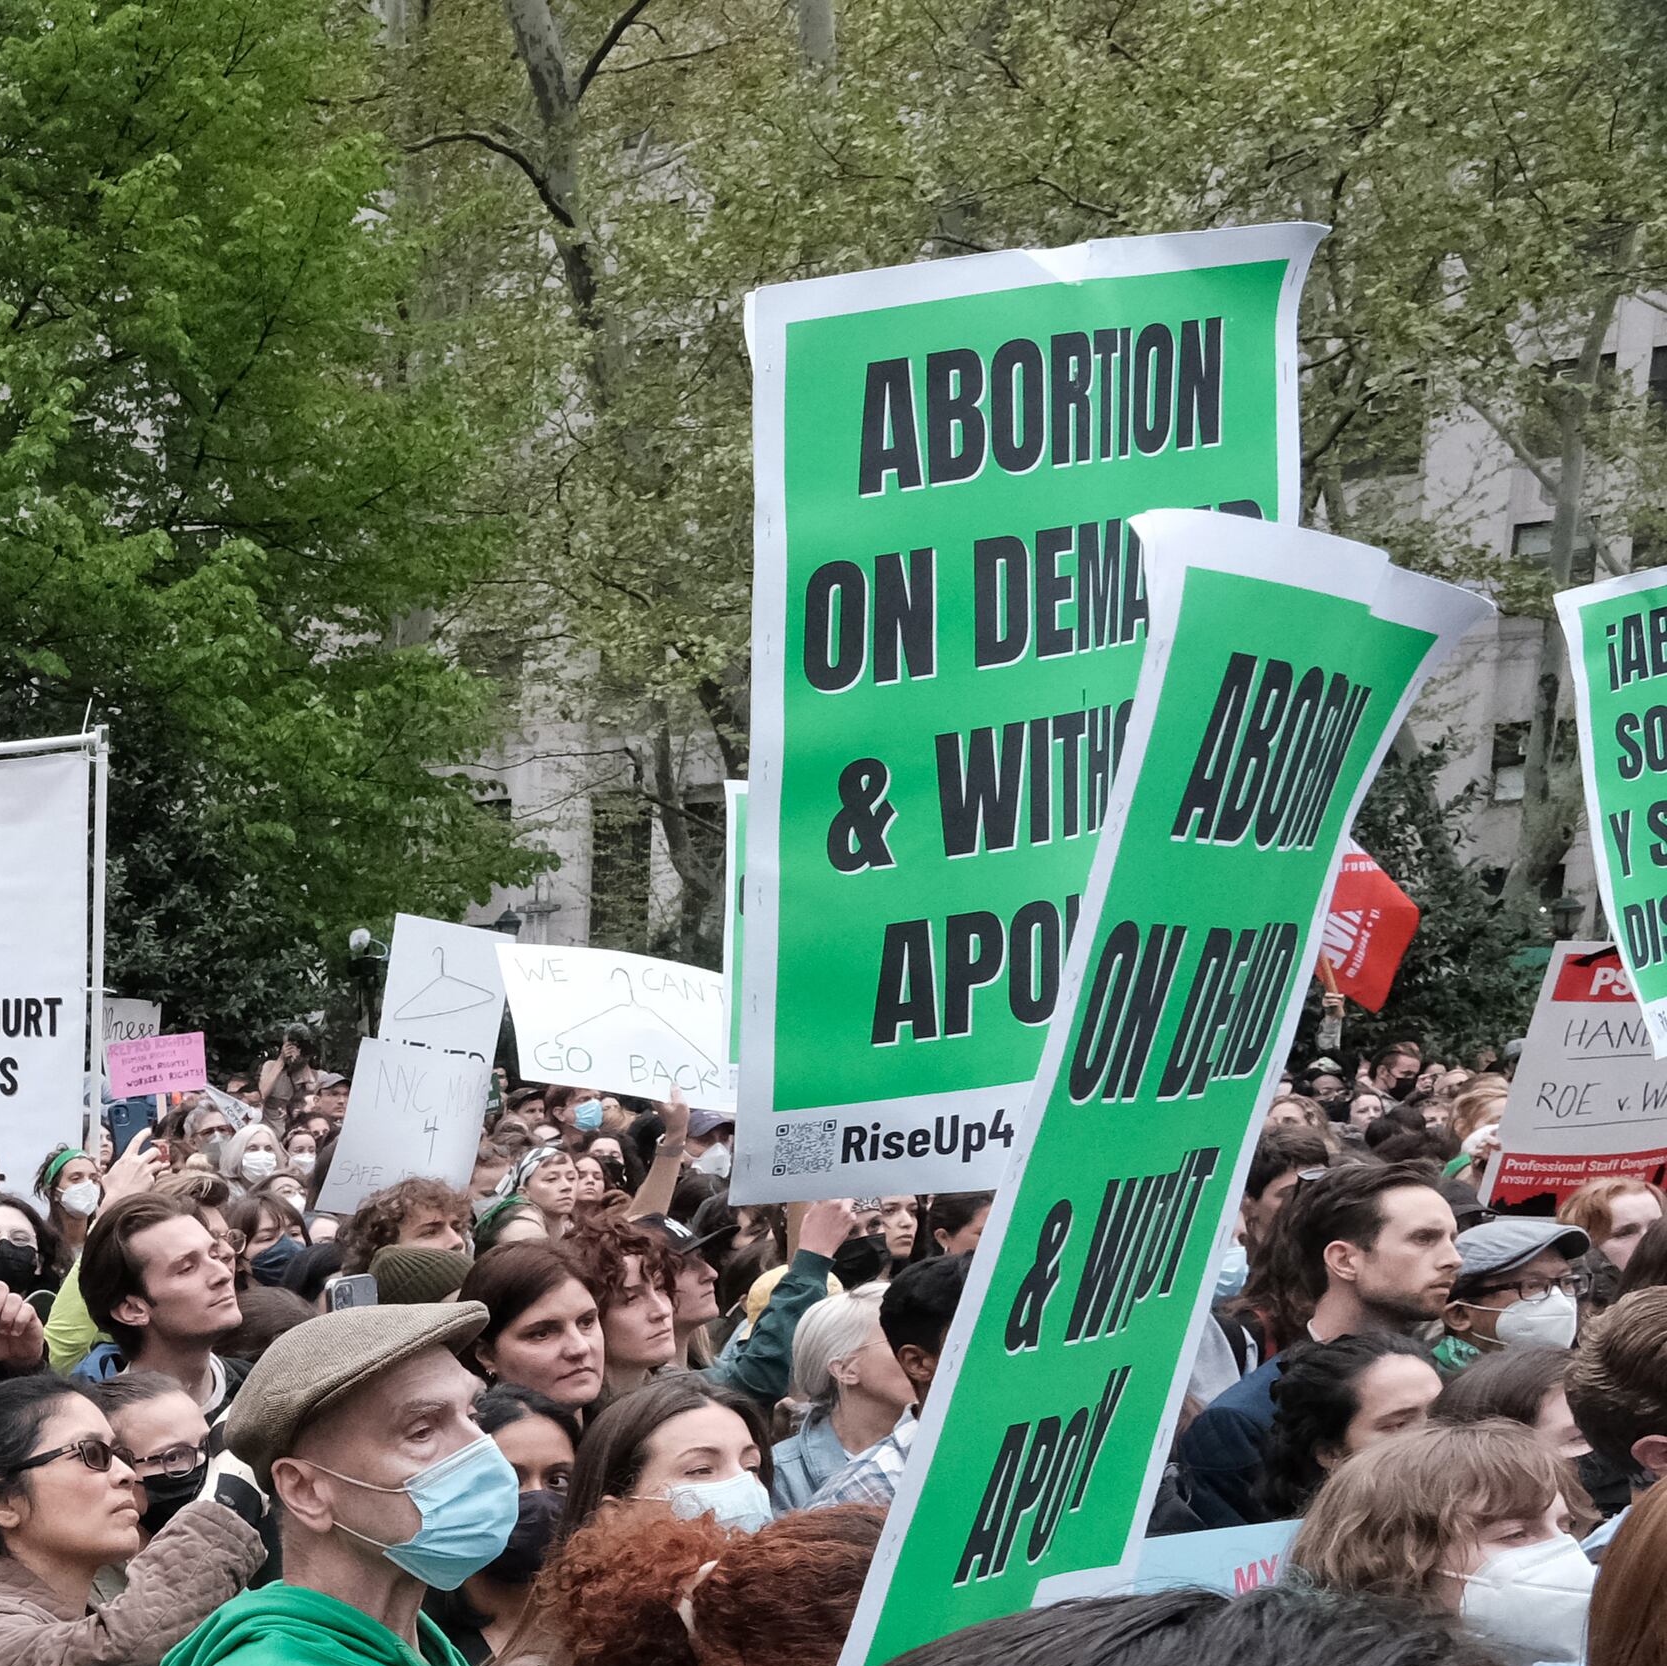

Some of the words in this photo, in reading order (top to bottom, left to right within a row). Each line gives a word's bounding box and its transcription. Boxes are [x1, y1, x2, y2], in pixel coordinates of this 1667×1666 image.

[858, 317, 1224, 499] ABORTION
[803, 547, 936, 694] ON
[826, 756, 896, 876] &
[1609, 808, 1633, 880] Y
[514, 957, 568, 984] WE
[1069, 920, 1187, 1105] ON
[108, 1040, 151, 1059] REPRO
[533, 1041, 593, 1074] GO
[628, 1053, 721, 1095] BACK
[126, 1075, 164, 1088] WORKERS
[373, 1060, 433, 1114] NYC
[1536, 1081, 1601, 1119] ROE
[331, 1160, 385, 1188] SAFE
[1501, 1175, 1534, 1184] NYSUT
[1543, 1177, 1562, 1186] AFT
[1505, 1158, 1585, 1172] Professional
[1587, 1159, 1620, 1171] Staff
[1004, 1199, 1073, 1356] &
[1234, 1554, 1278, 1598] MY
